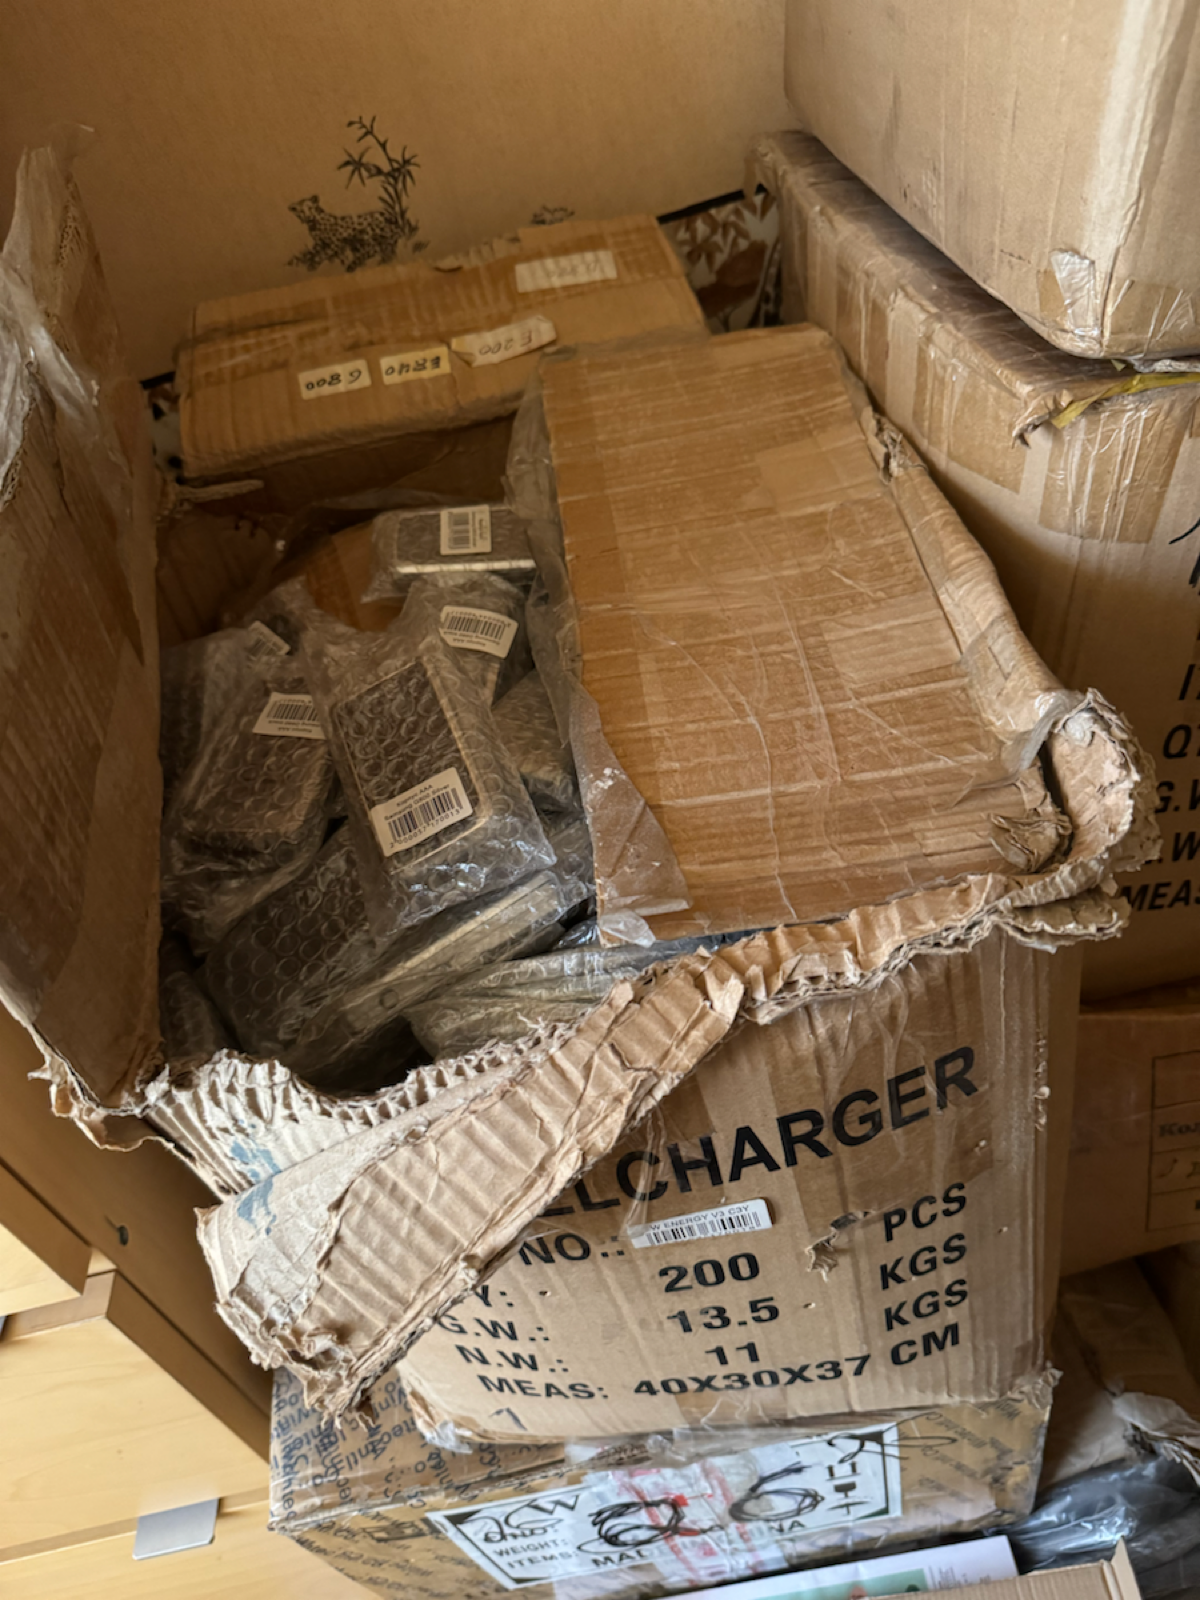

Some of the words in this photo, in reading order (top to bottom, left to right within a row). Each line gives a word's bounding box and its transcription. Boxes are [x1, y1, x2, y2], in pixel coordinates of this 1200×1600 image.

[305, 372, 342, 393] 800
[659, 1252, 761, 1294] 200
[883, 1181, 968, 1243] PCS
[663, 1213, 709, 1229] ENERGY
[666, 1297, 781, 1333] 13.5
[879, 1232, 968, 1292] KGS
[705, 1342, 761, 1367] 11
[884, 1278, 969, 1333] KGS
[476, 1374, 609, 1400] MEAS:
[633, 1353, 872, 1397] 40X30X37
[890, 1321, 961, 1367] CM
[493, 1539, 569, 1558] WEIGHT:
[506, 1550, 580, 1569] ITEMS:
